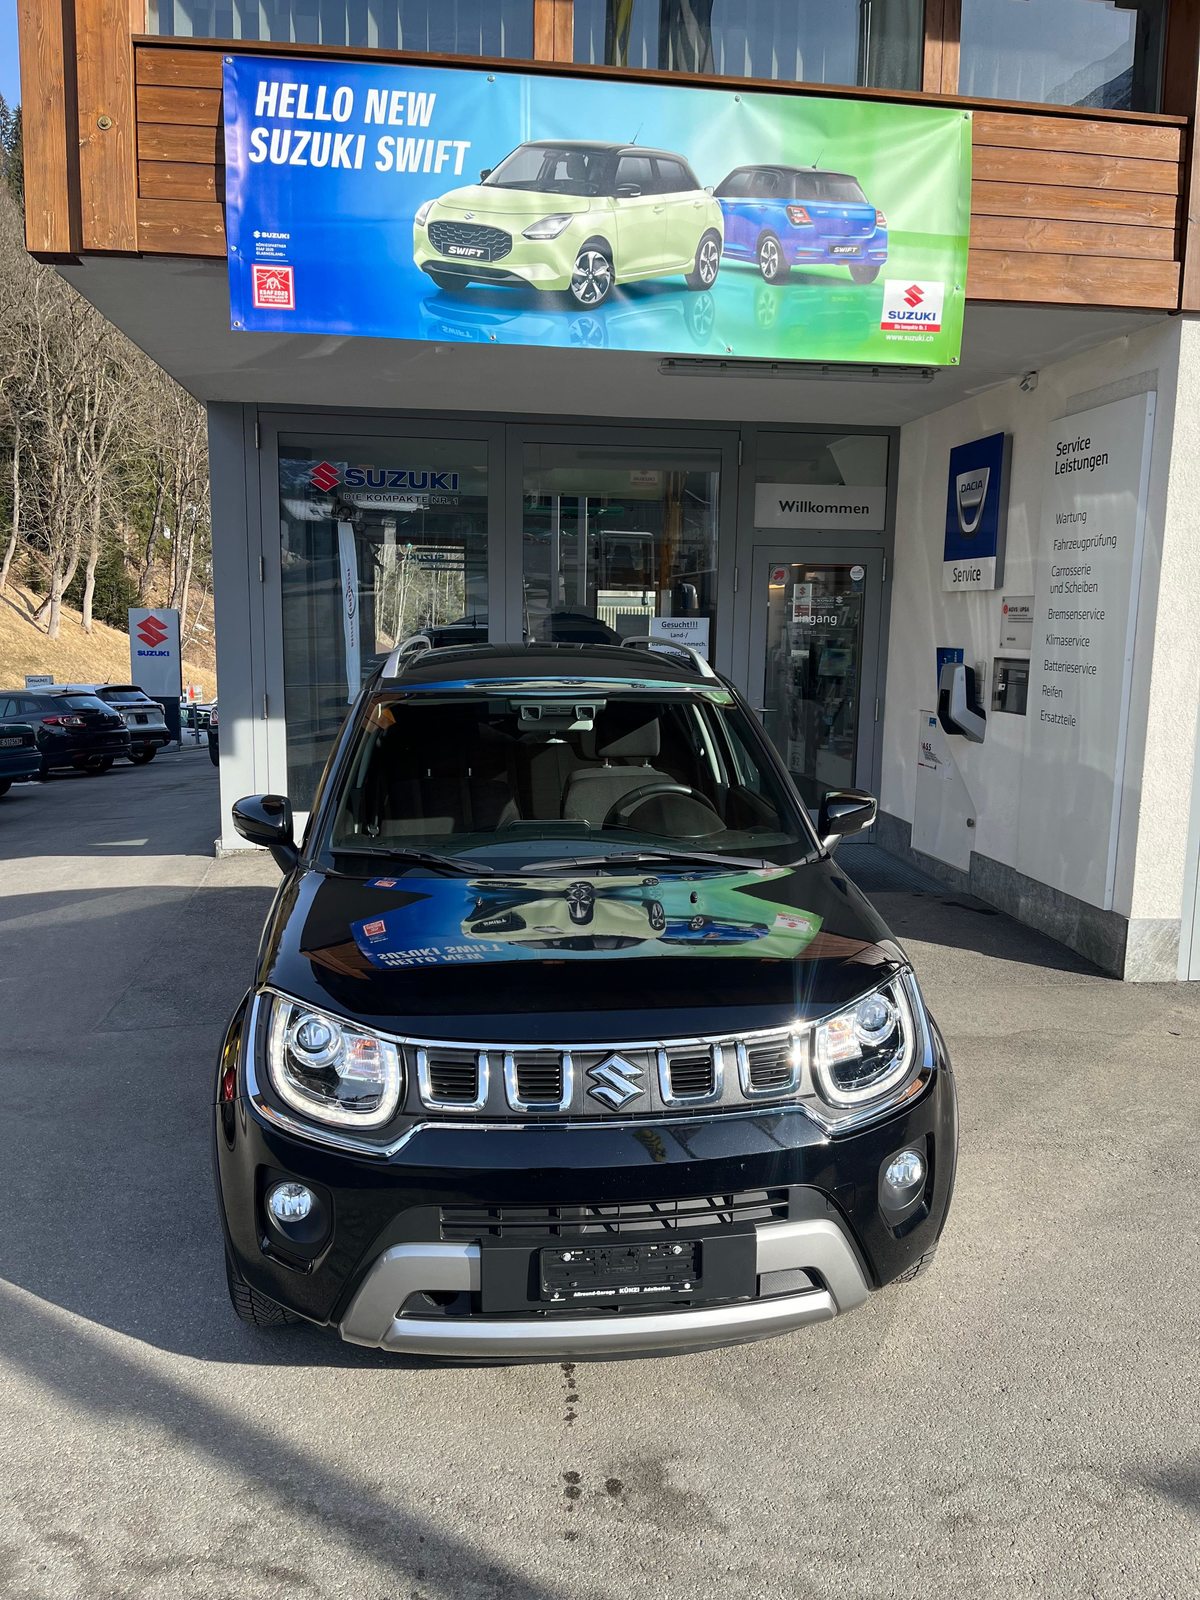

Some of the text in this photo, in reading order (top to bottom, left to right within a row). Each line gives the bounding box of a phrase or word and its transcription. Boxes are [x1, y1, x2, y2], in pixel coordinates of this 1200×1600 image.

[255, 81, 436, 127] HELLO NEW
[248, 127, 471, 176] SUZUKI SWIFT
[448, 246, 484, 257] SWIFT
[888, 310, 936, 321] SUZUKI
[1056, 436, 1091, 457] Service
[1055, 453, 1108, 475] Leistungen
[344, 468, 460, 490] SUZUKI
[960, 480, 983, 493] DACIA
[366, 494, 428, 503] KOMPAKTE
[432, 496, 451, 504] NR.
[778, 500, 869, 514] Willkommen
[1056, 512, 1087, 524] Wartung
[1053, 534, 1117, 551] Fahrzeugprüfung
[953, 566, 981, 583] Service
[1051, 564, 1092, 577] Carrosserie
[1050, 581, 1098, 593] und Scheiben
[793, 612, 838, 625] Eingang
[1048, 608, 1105, 620] Bremsenservice
[1046, 634, 1090, 647] Klimaservice
[1044, 660, 1097, 675] Batterieservice
[1042, 685, 1062, 698] Reifen
[1040, 710, 1076, 726] Ersatzteile
[573, 1289, 615, 1297] Allround-Garage
